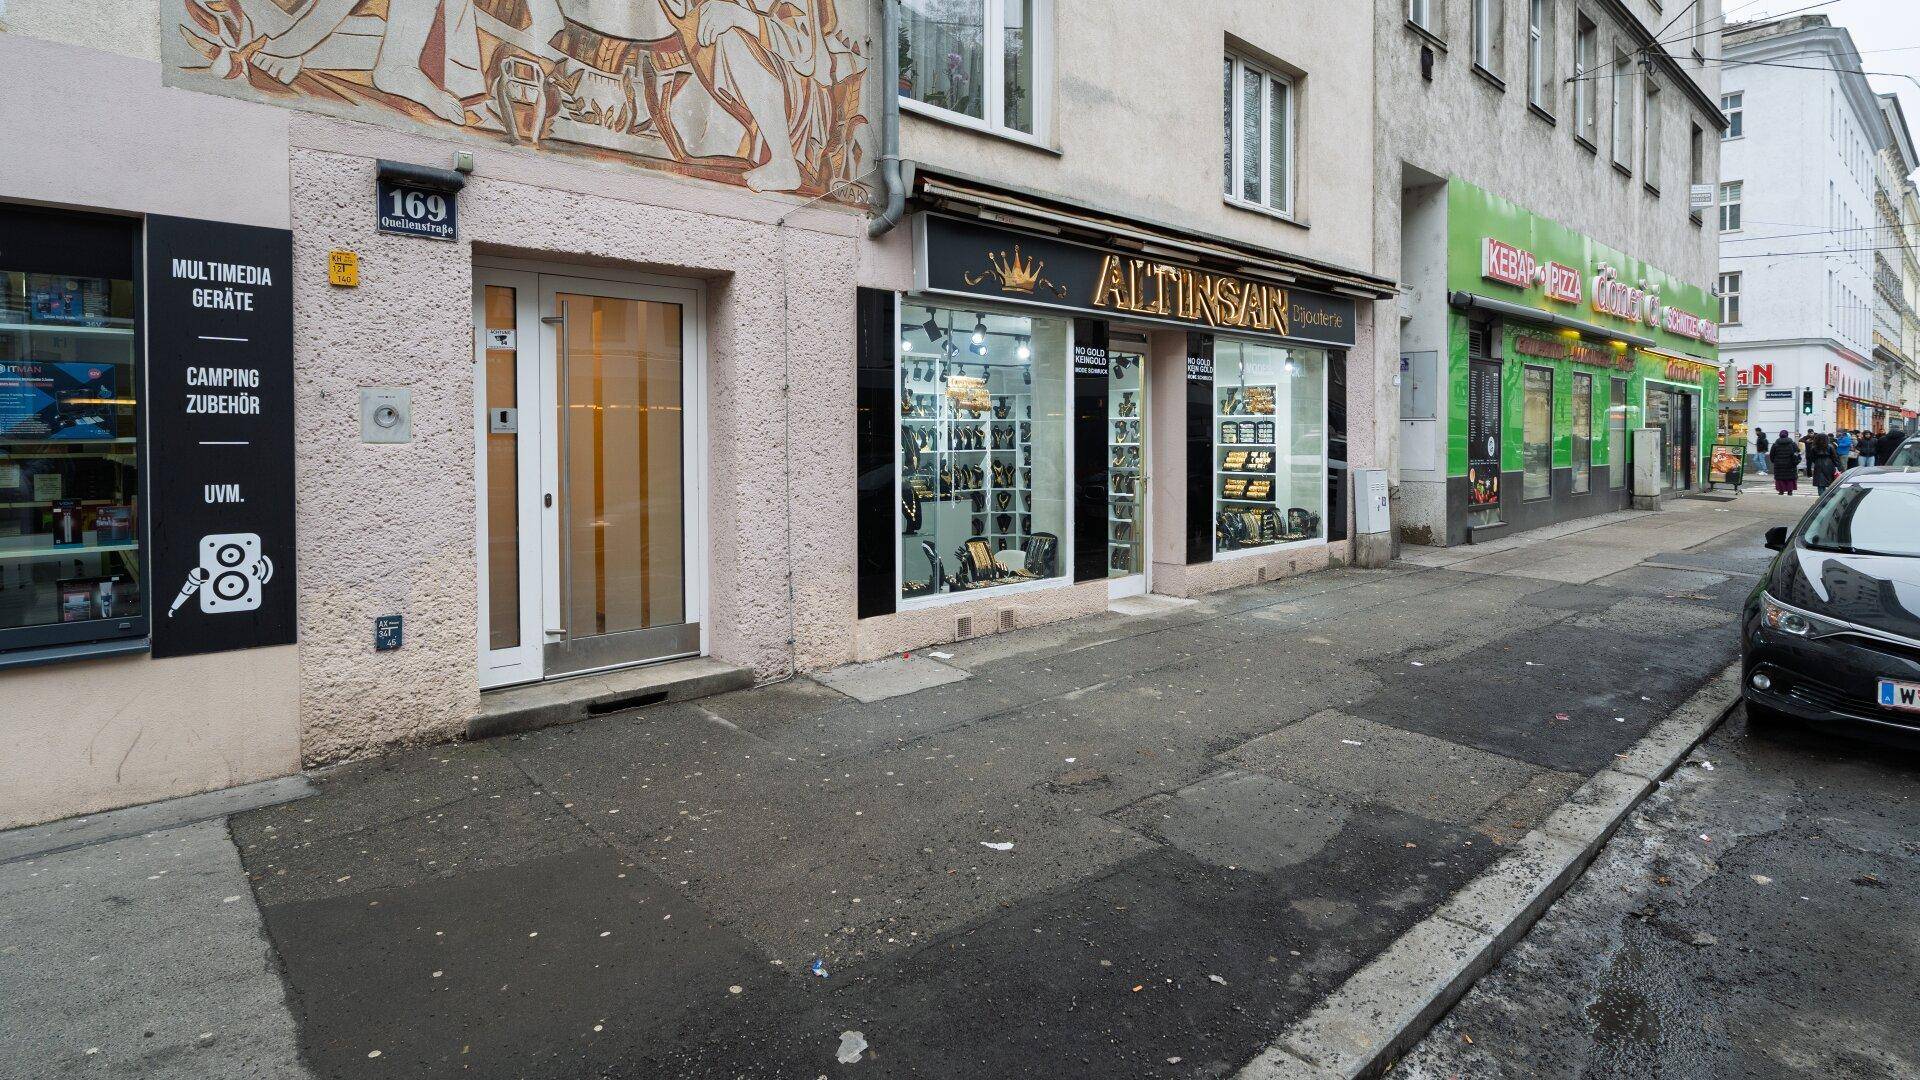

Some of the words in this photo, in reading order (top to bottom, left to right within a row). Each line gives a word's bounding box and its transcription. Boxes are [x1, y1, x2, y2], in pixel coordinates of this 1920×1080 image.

[389, 188, 447, 222] 169
[381, 216, 454, 237] Quellenstraße
[172, 258, 273, 286] MULTIMEDIA
[1489, 239, 1535, 285] KEBAP
[1094, 255, 1289, 336] ALTINSAN
[1551, 266, 1582, 302] PIZZA
[192, 287, 254, 311] GERÄTE
[1293, 304, 1343, 328] Bijouterie
[1075, 346, 1086, 355] NO
[1087, 347, 1105, 357] GOLD
[1187, 356, 1196, 364] NO
[1196, 357, 1211, 366] GOLD
[186, 366, 260, 388] CAMPING
[1199, 363, 1214, 374] GOLD
[186, 392, 260, 415] ZUBEHÖR
[204, 484, 245, 504] UVM.
[1900, 687, 1916, 705] W
